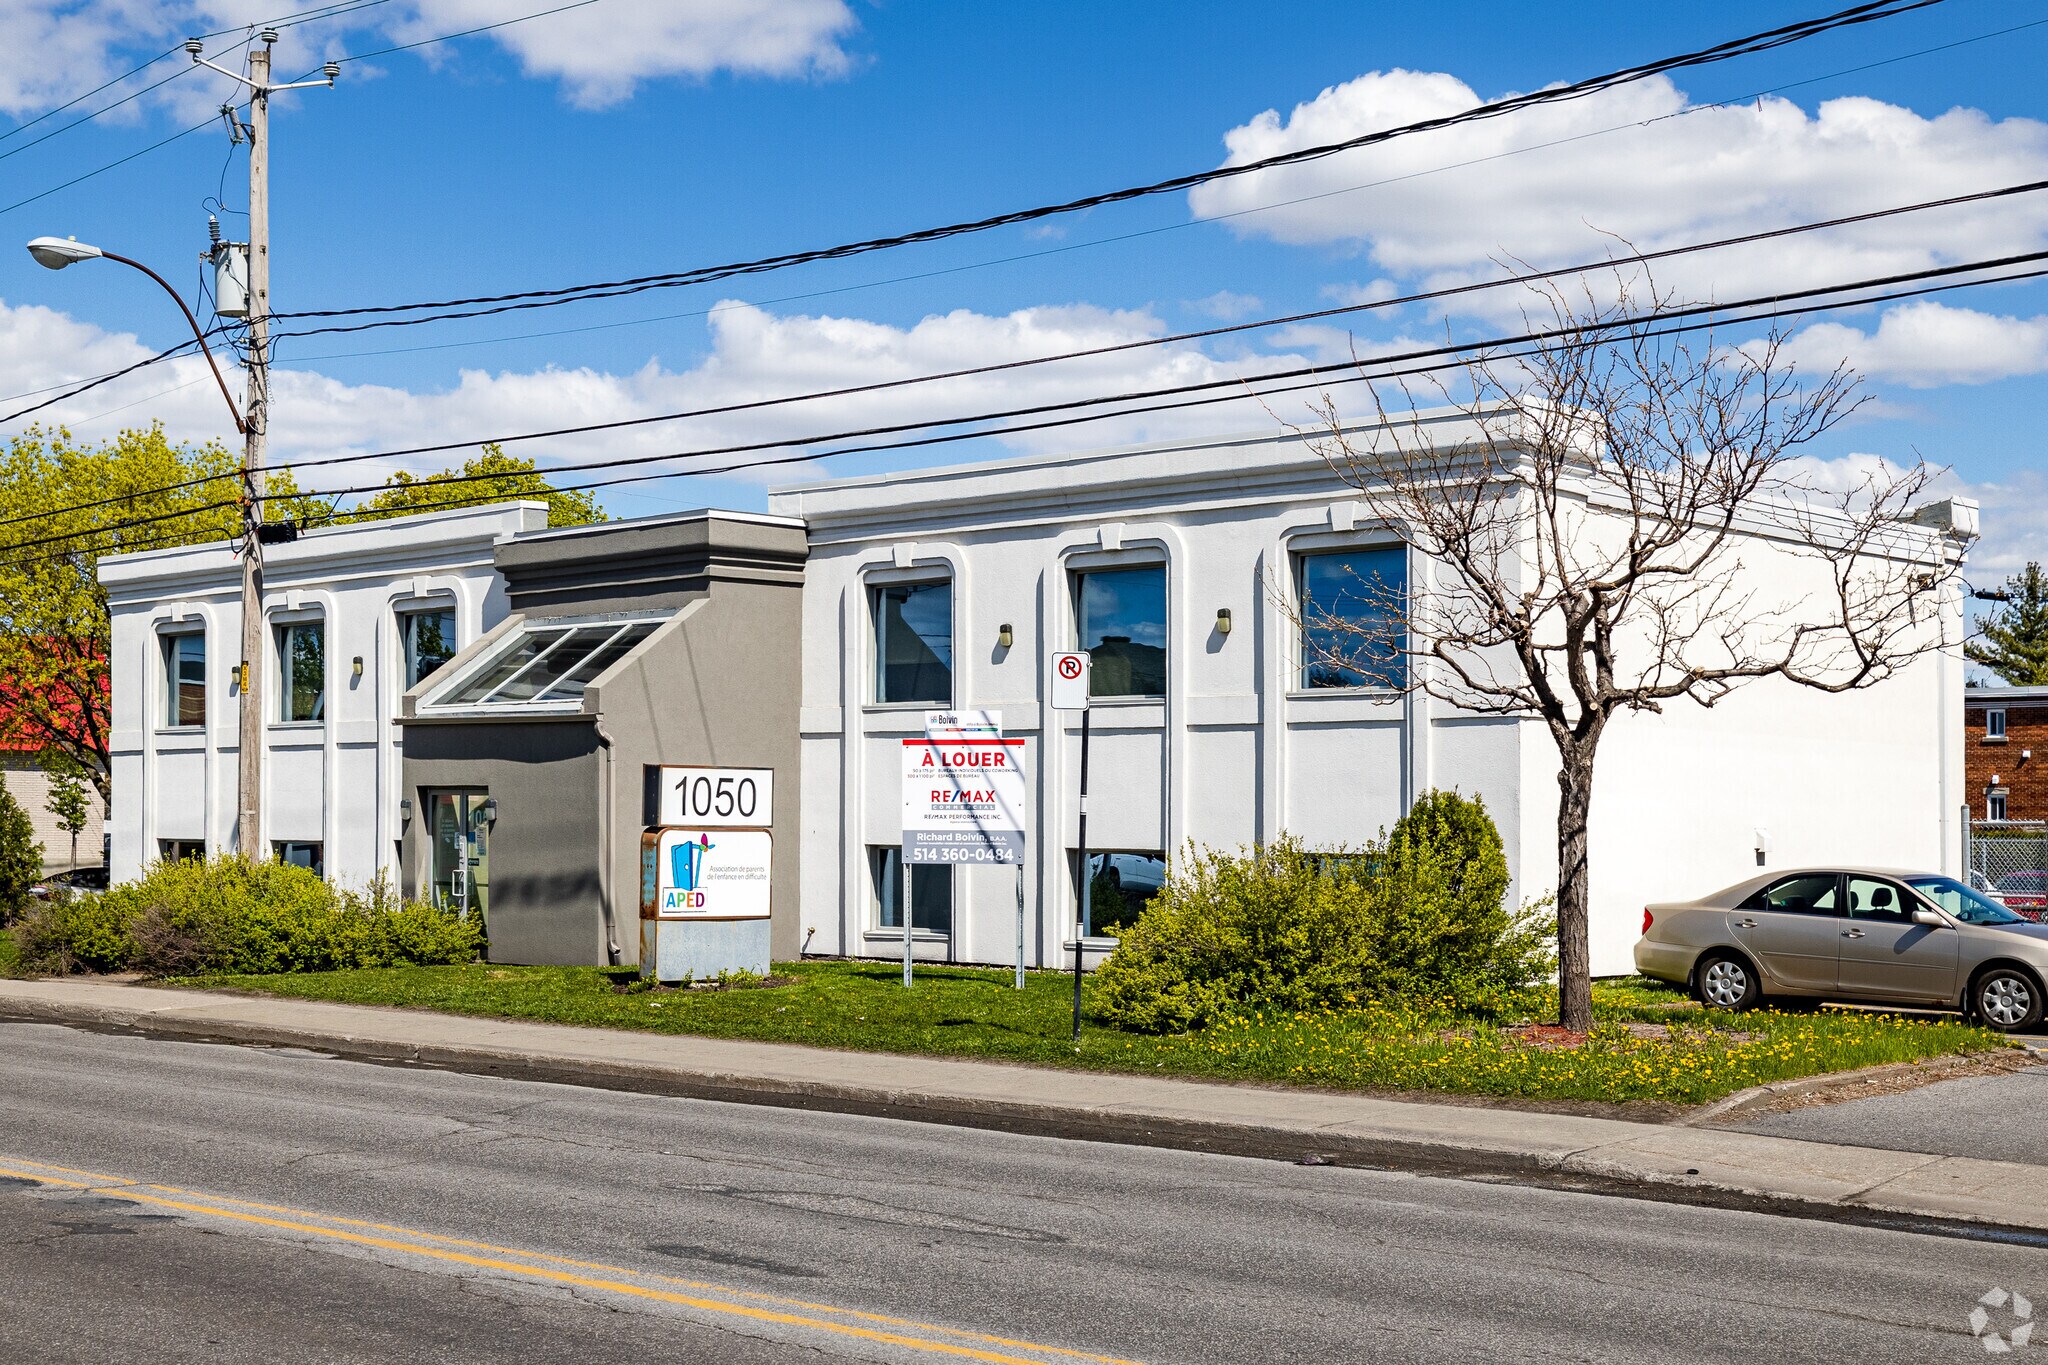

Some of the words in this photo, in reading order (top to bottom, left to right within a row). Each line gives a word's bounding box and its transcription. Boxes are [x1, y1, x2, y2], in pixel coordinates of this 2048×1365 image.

[938, 714, 958, 724] Boivin
[921, 749, 935, 767] À
[942, 752, 1006, 767] LOUER
[675, 775, 757, 817] 1050
[931, 790, 996, 803] RE/MAX
[916, 833, 953, 841] Richard
[955, 833, 987, 842] Boivin,
[913, 848, 938, 861] 514
[941, 848, 1014, 861] 360-0484
[665, 892, 705, 908] APED
